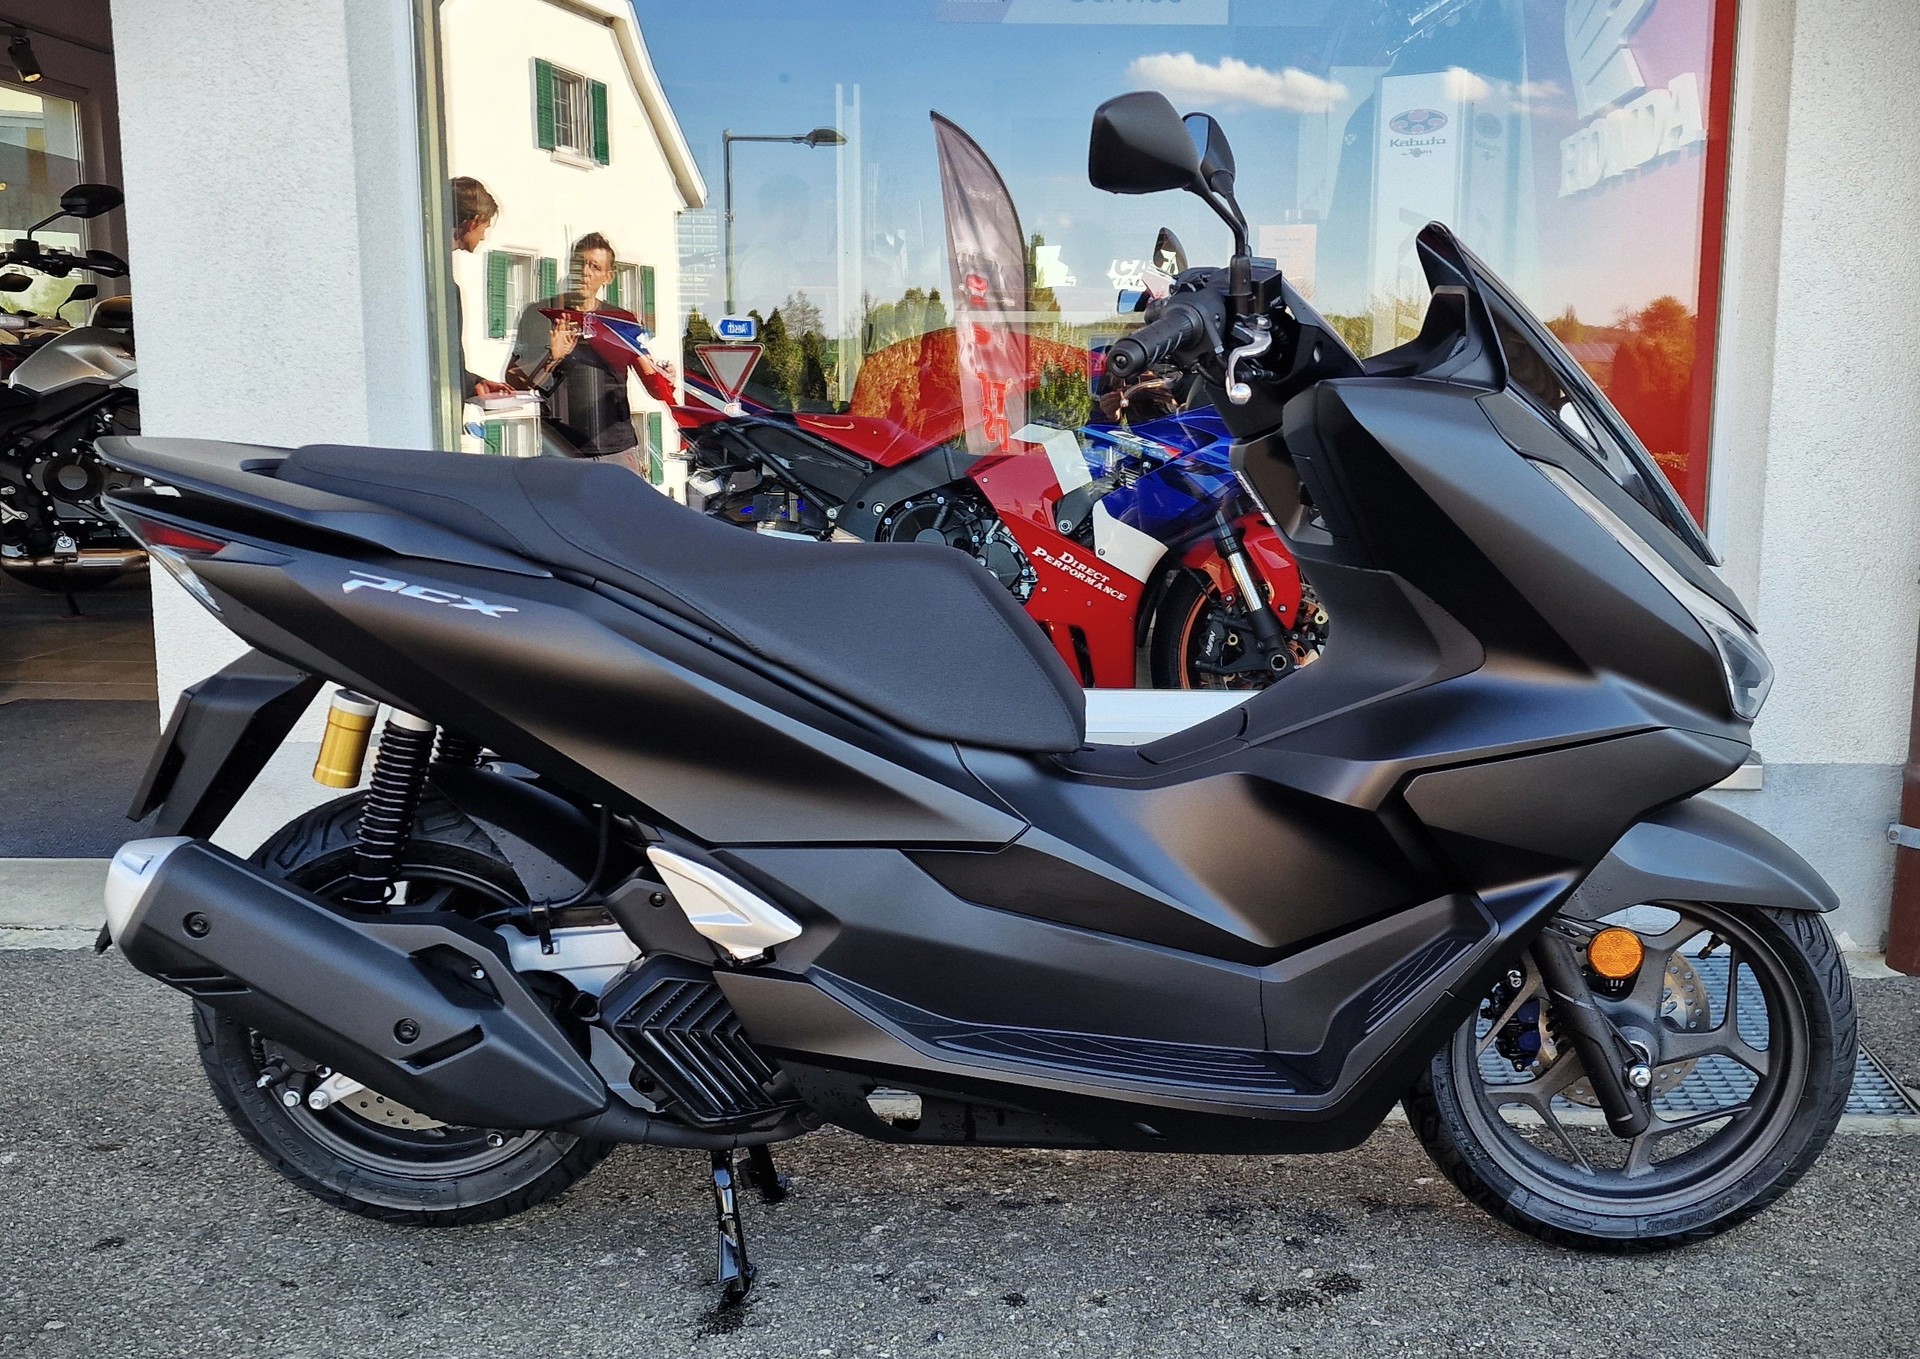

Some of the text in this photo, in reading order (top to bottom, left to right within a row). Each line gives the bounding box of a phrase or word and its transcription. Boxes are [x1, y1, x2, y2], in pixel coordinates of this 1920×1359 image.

[1389, 136, 1447, 148] Kabuto
[1558, 72, 1708, 199] HONDA
[1031, 546, 1127, 601] PERFORMANCE
[1058, 551, 1110, 583] DIRECT
[342, 570, 519, 618] PCX
